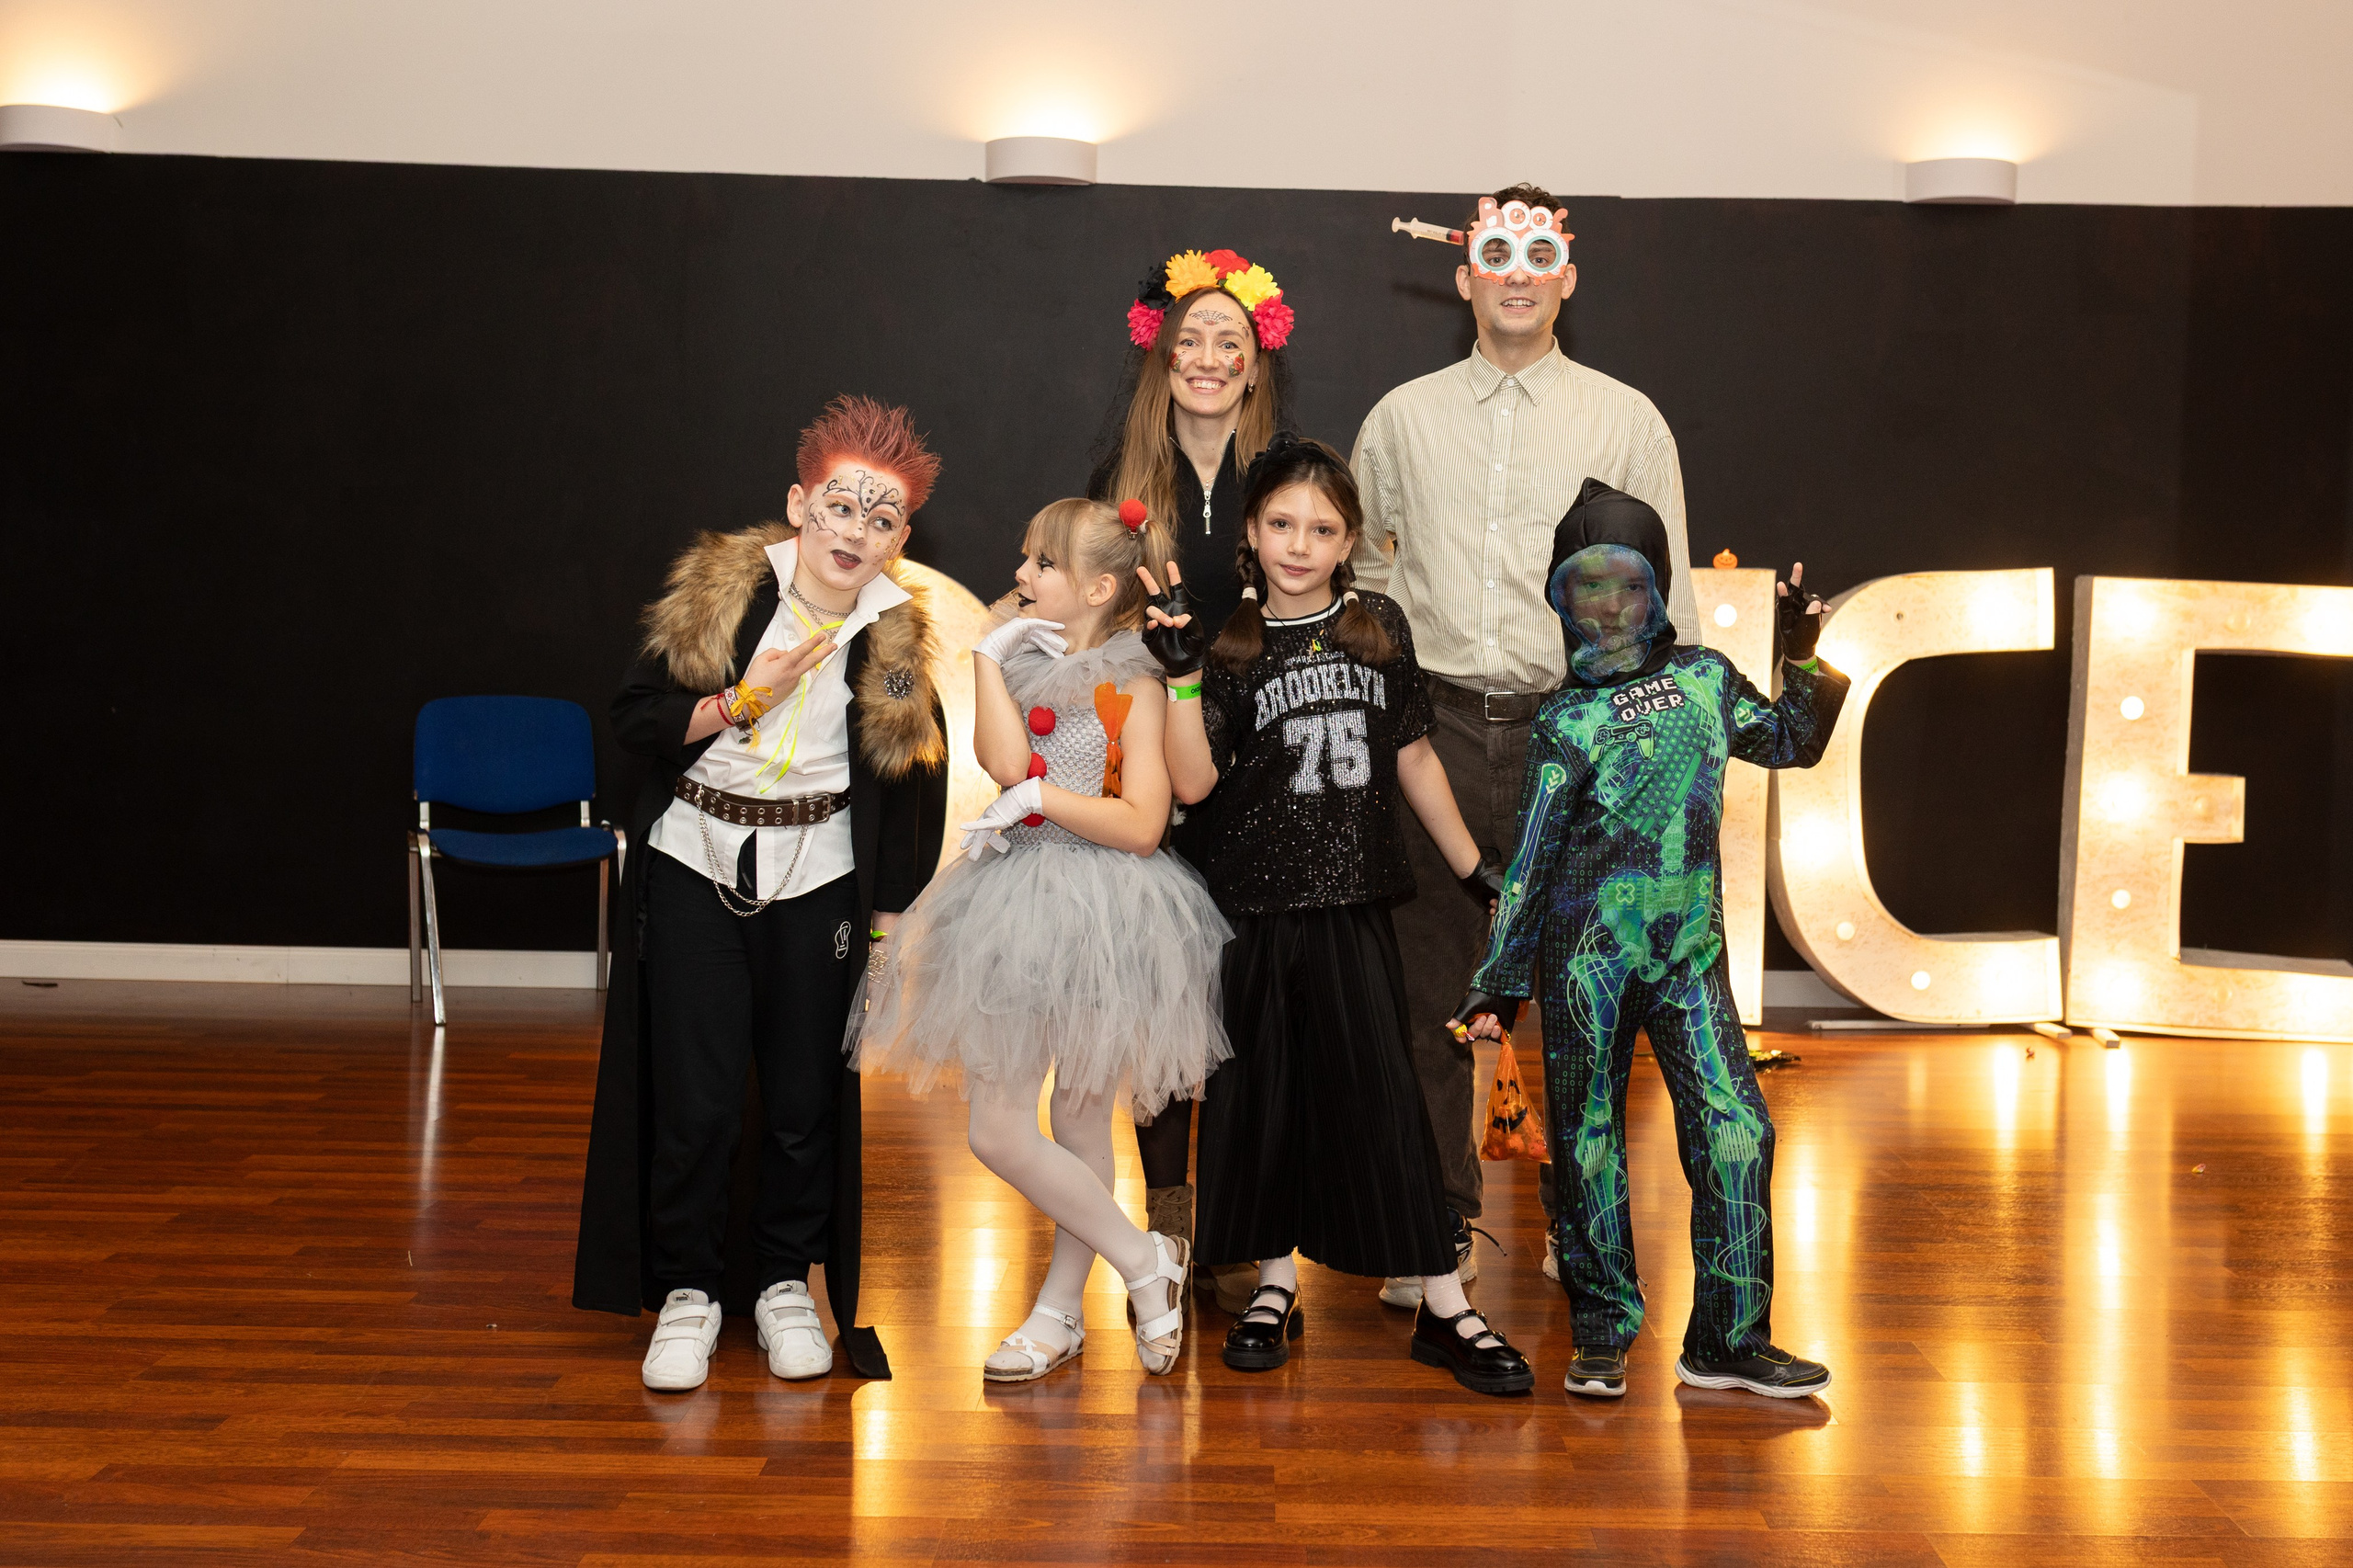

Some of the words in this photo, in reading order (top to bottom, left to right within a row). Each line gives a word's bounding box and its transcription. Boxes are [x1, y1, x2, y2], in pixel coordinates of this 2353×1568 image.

[1254, 663, 1386, 732] BROOKLYN
[1613, 677, 1677, 706] GAME
[1621, 694, 1685, 722] OVER
[1282, 709, 1372, 795] 75
